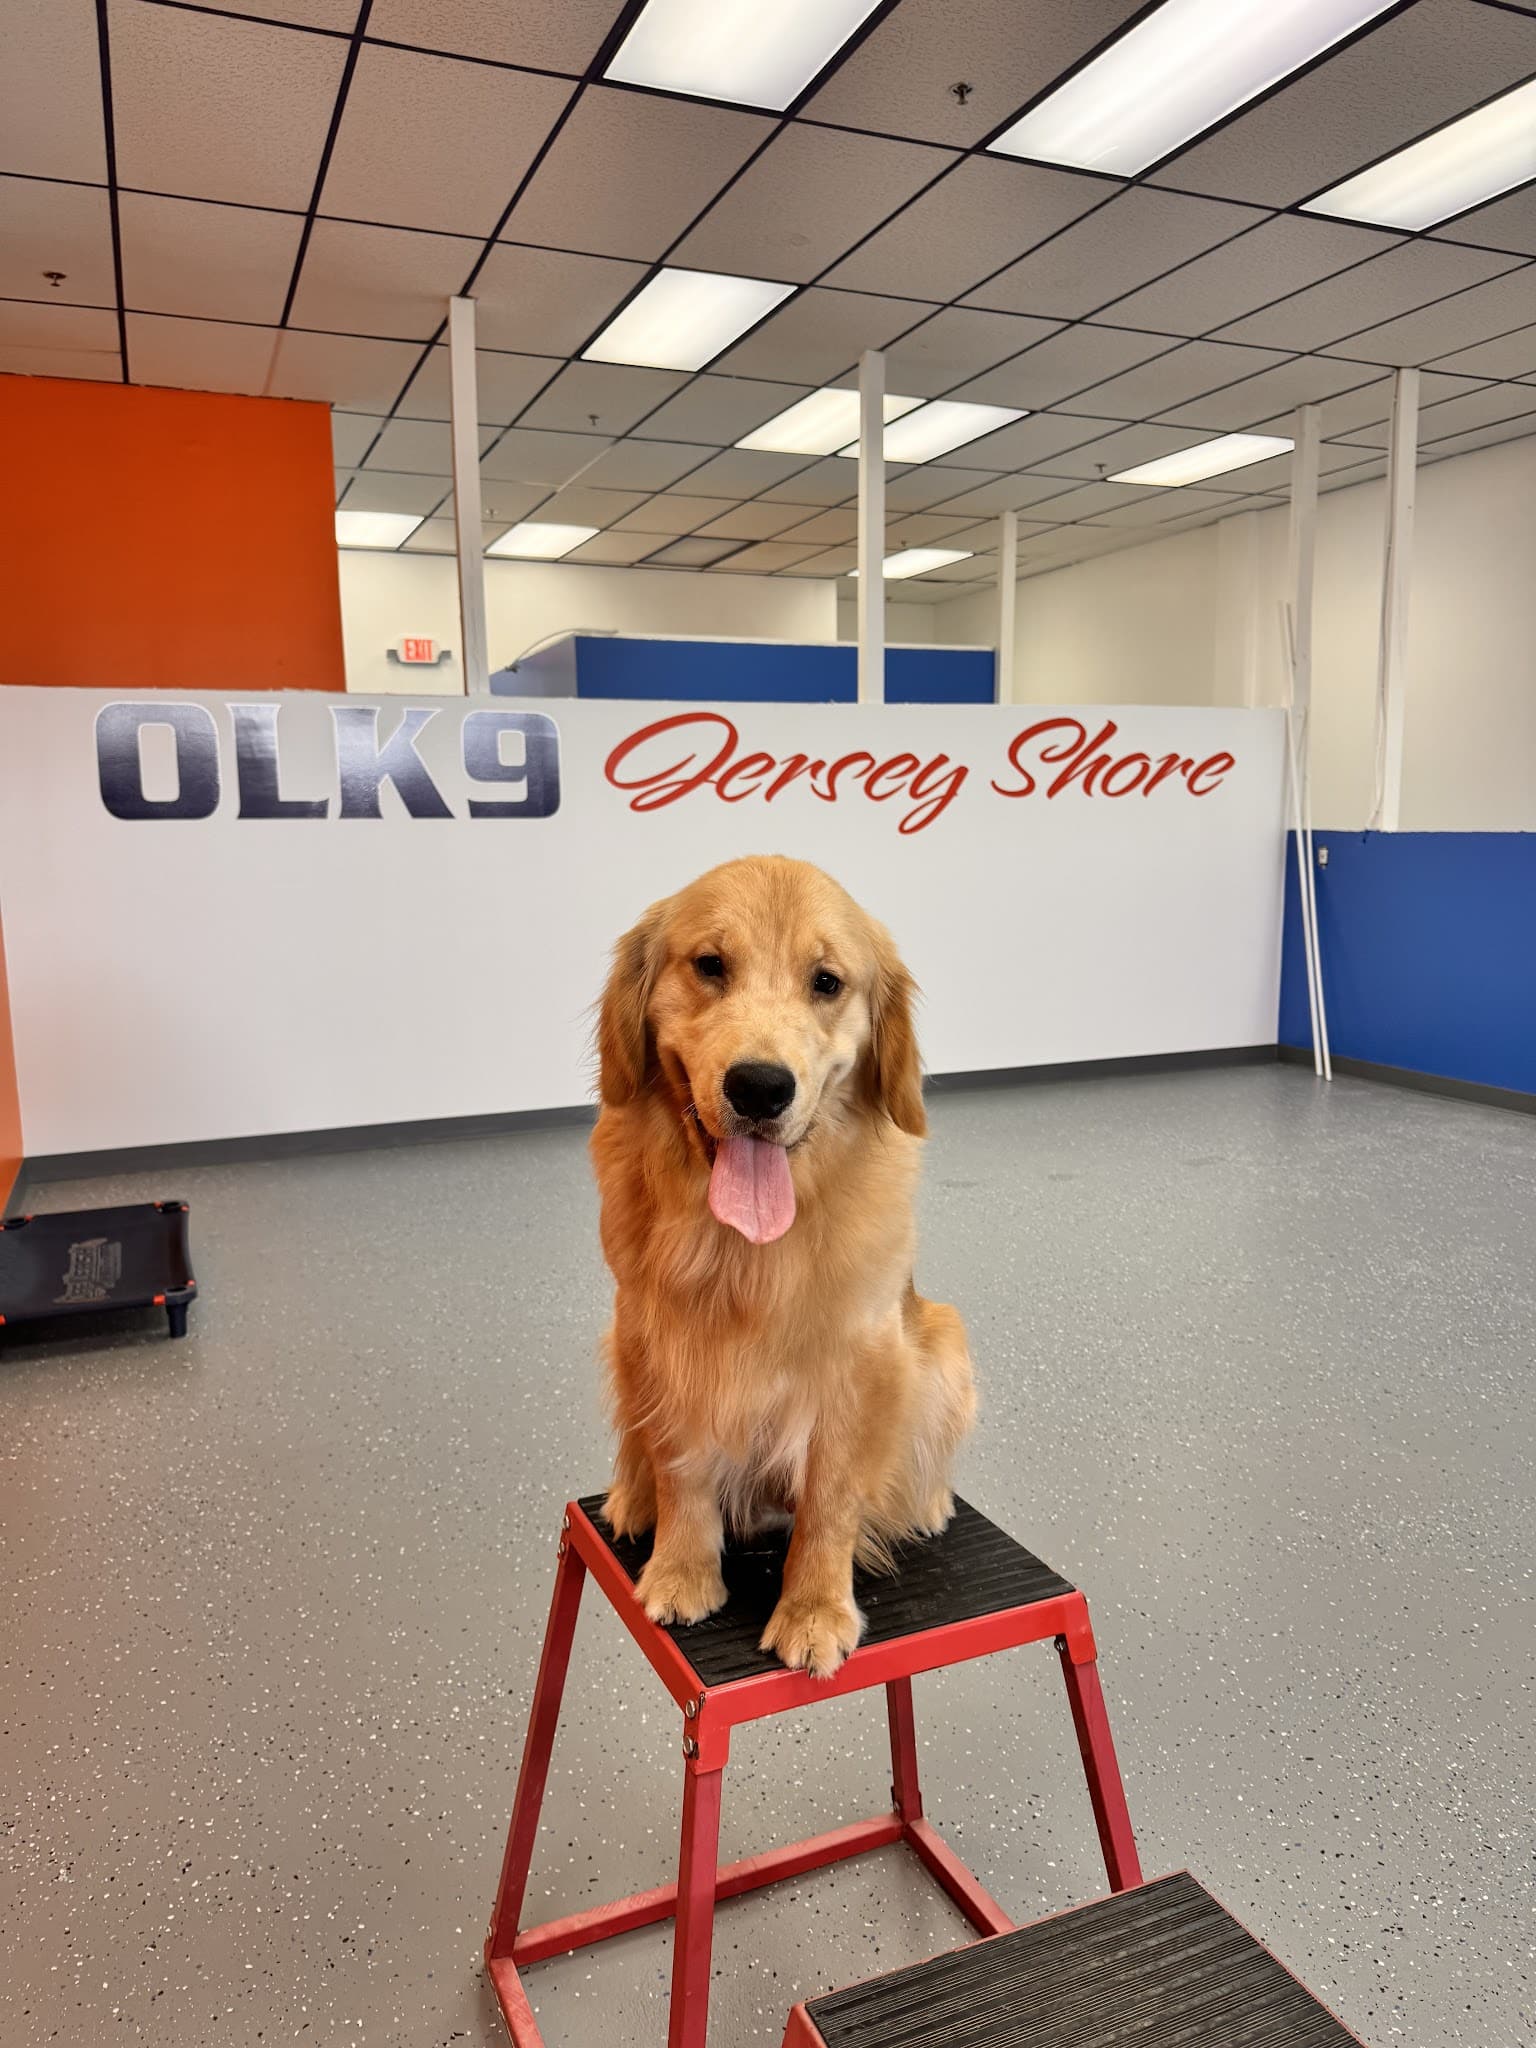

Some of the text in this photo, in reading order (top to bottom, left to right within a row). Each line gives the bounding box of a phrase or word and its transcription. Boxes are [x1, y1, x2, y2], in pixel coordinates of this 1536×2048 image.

[404, 638, 433, 662] EXIT
[95, 702, 1235, 835] OLK9 Jersey Shore
